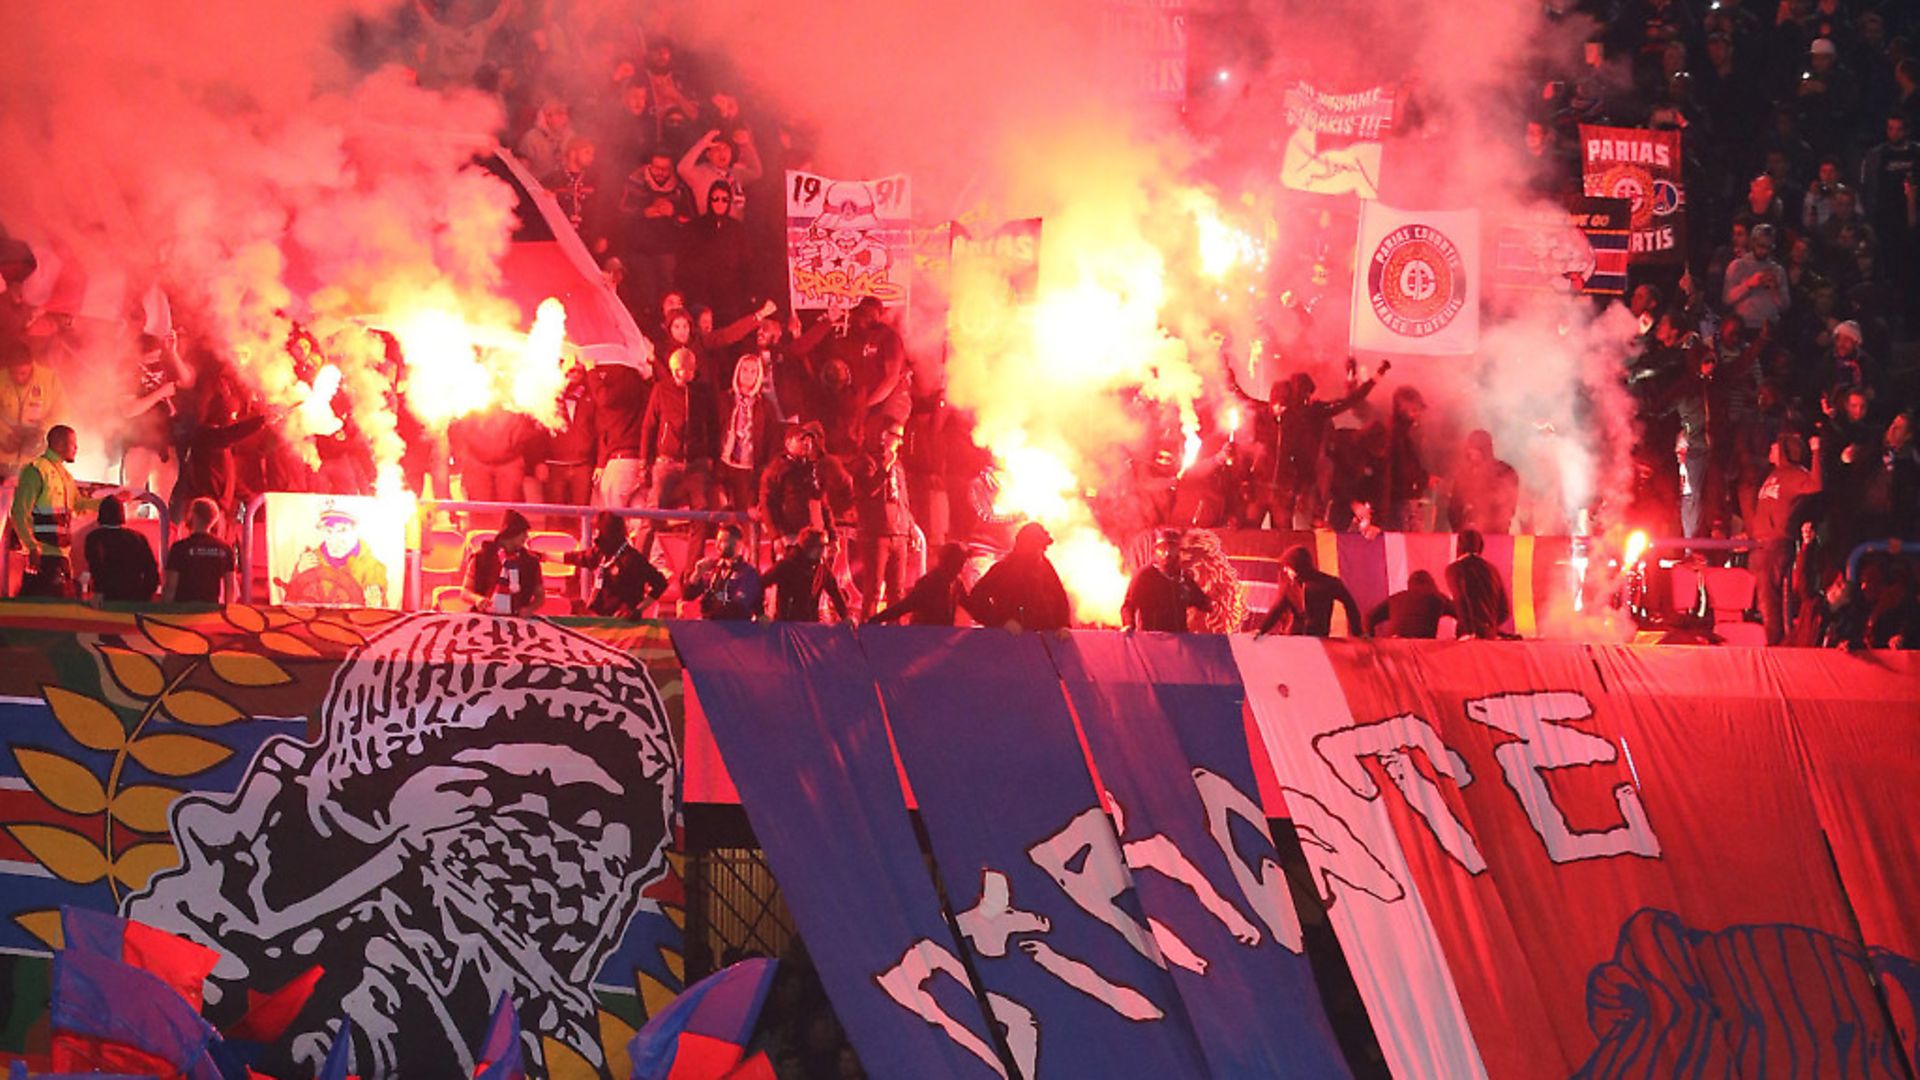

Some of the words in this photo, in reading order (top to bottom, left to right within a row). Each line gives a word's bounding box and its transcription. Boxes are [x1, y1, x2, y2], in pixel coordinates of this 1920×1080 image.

[1586, 139, 1671, 168] PARIAS
[794, 175, 820, 203] 19
[876, 178, 905, 205] 91
[1375, 228, 1411, 265] PARIAS
[1631, 224, 1675, 253] RTIS
[1372, 293, 1409, 335] VIRAGE
